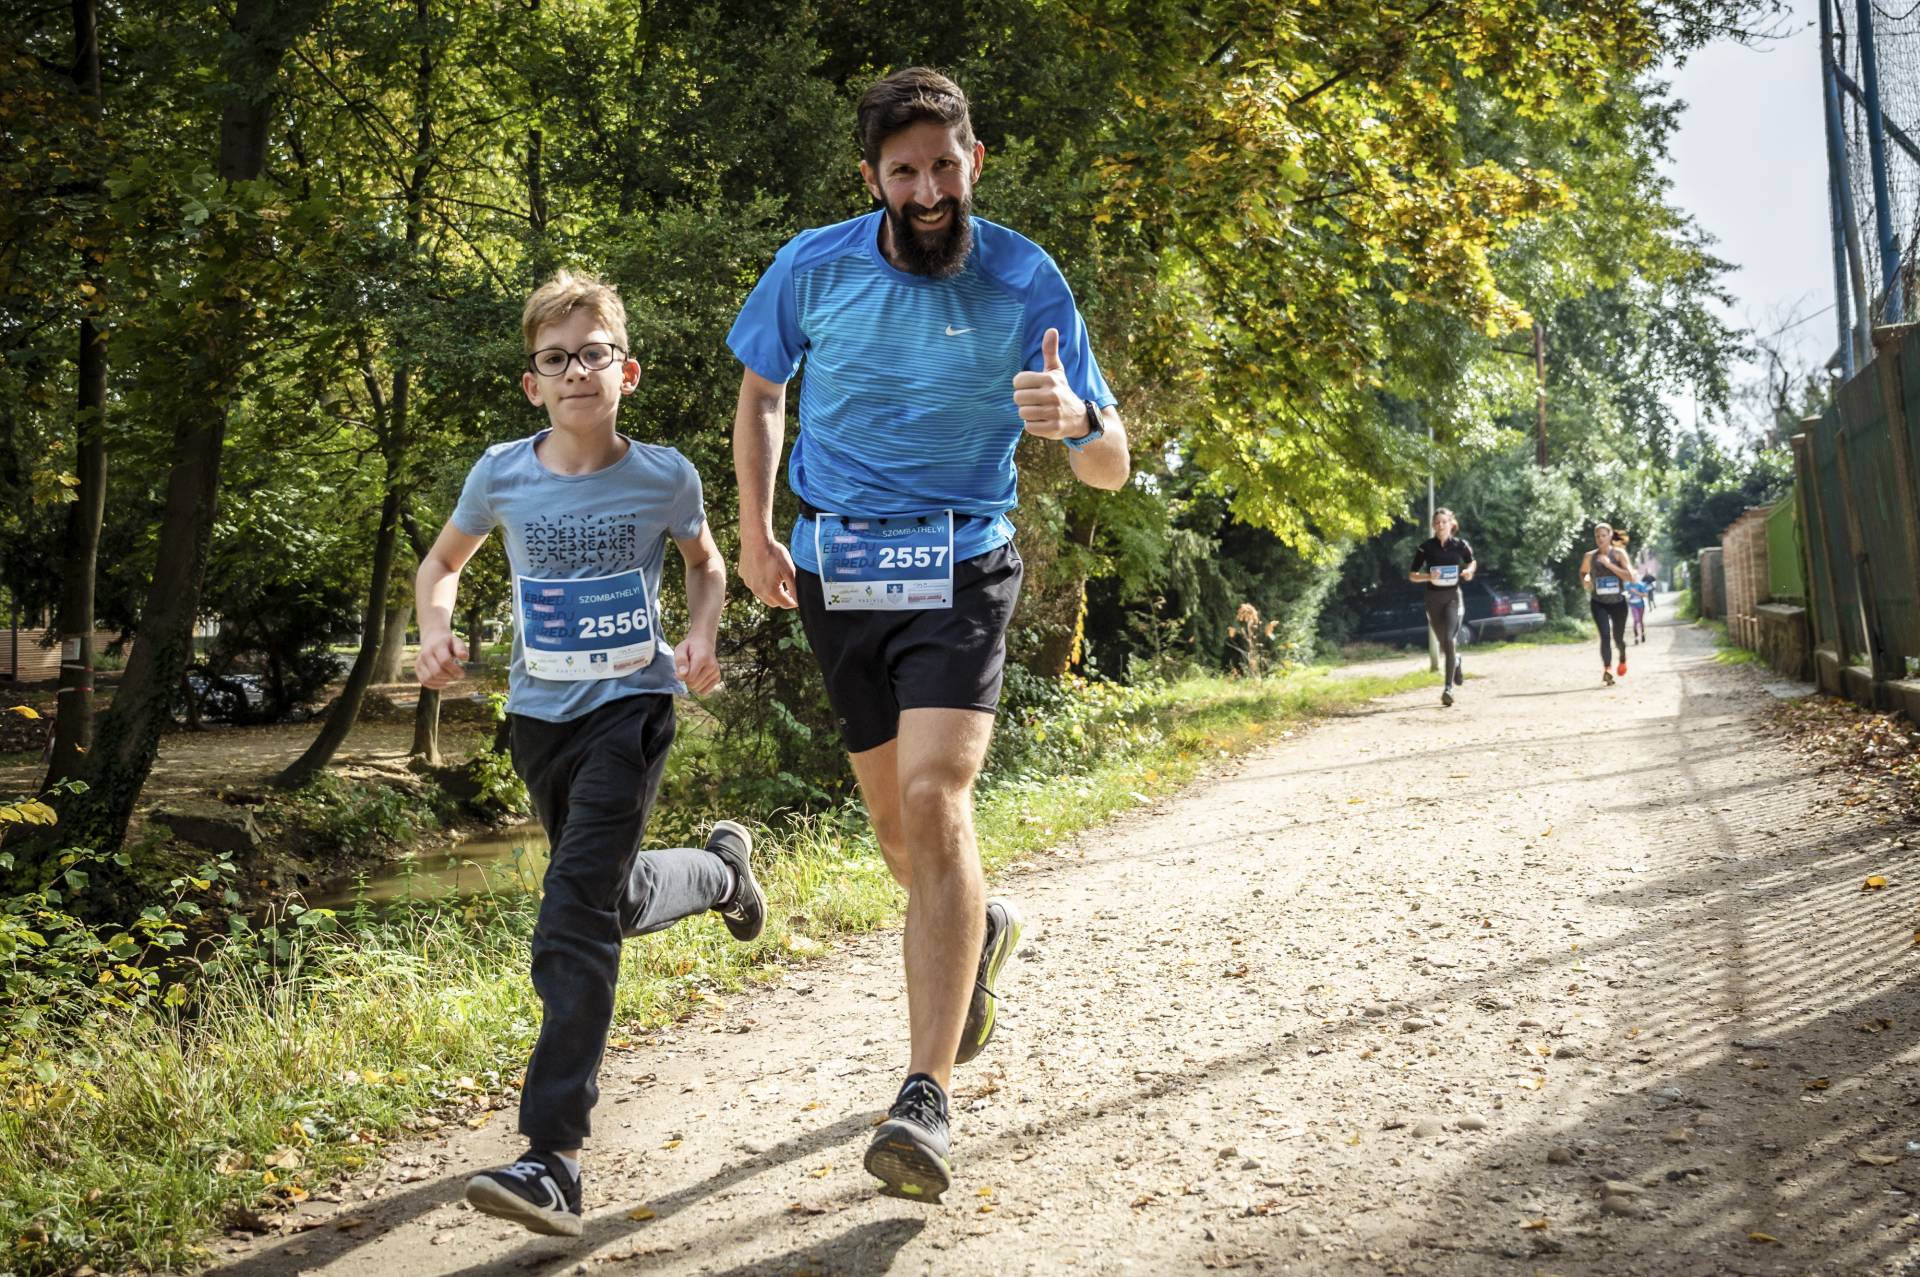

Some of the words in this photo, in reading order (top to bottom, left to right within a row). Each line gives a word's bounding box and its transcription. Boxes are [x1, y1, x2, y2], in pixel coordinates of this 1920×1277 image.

[878, 546, 949, 569] 2557
[579, 586, 640, 604] SZOMBATHELY!
[578, 608, 648, 639] 2556
